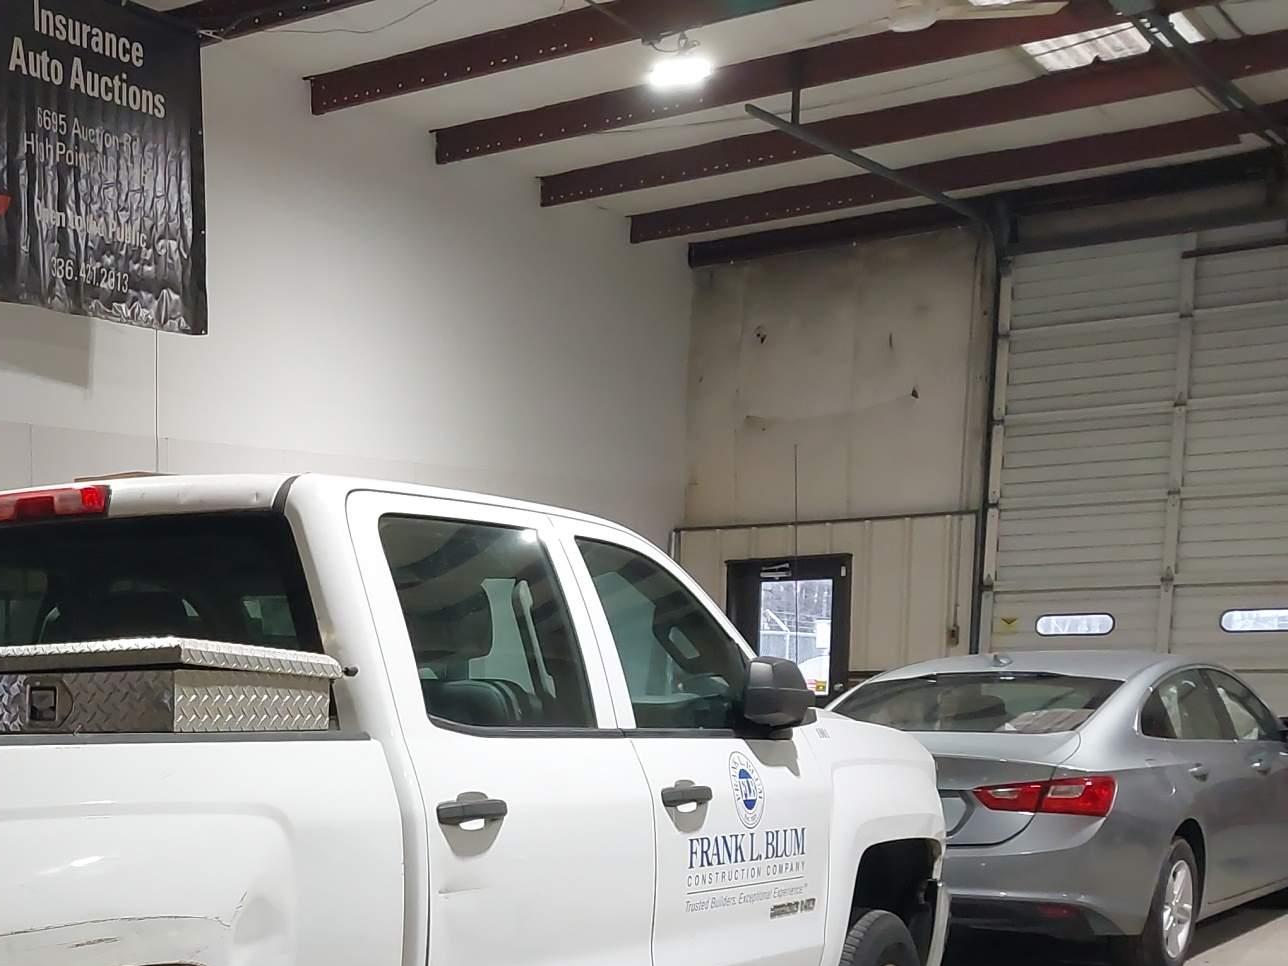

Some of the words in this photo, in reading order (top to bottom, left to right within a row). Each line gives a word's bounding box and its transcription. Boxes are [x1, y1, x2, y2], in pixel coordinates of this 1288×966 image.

[34, 0, 144, 67] Insurance
[9, 36, 64, 86] Auto
[70, 56, 166, 119] Auctions
[37, 106, 67, 135] 6695
[688, 833, 746, 869] FRANK
[749, 832, 762, 862] L.
[764, 827, 806, 860] BLUM
[687, 866, 762, 888] CONSTRUCTION
[766, 861, 806, 877] COMPANY
[685, 897, 712, 913] Trusted
